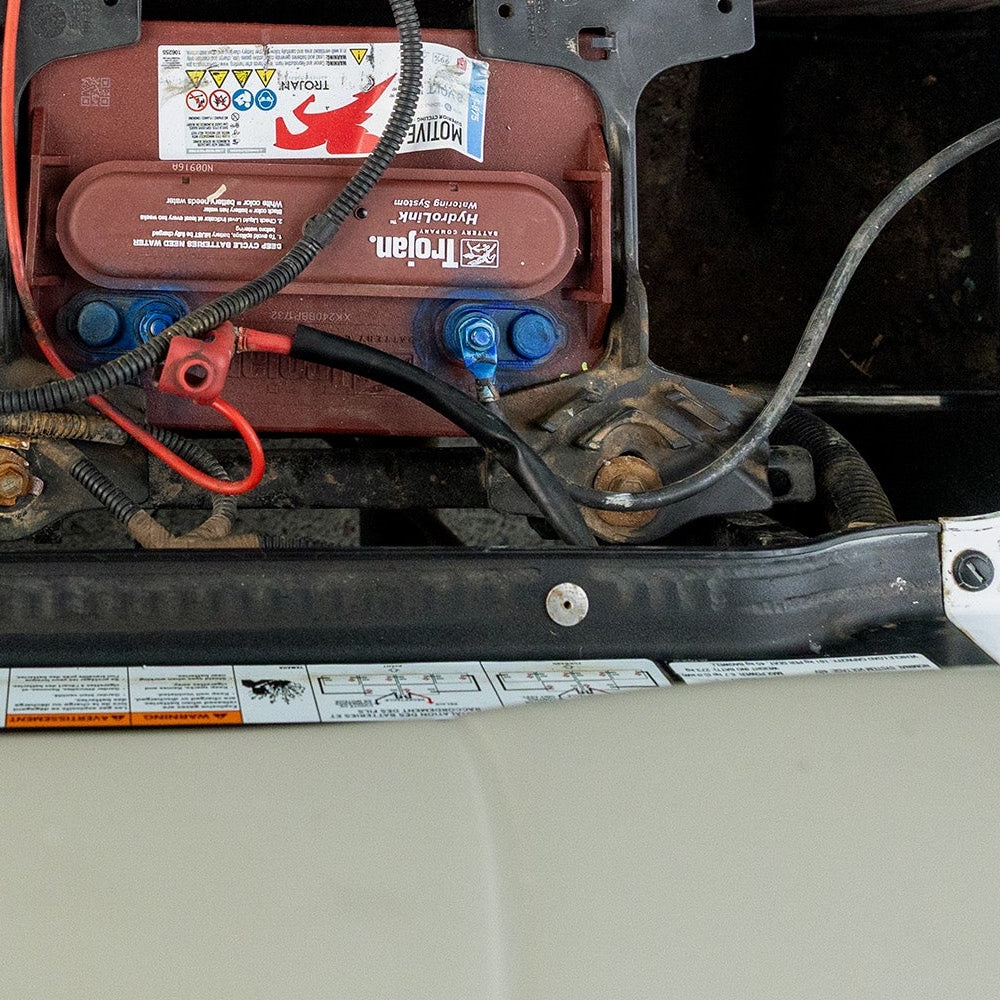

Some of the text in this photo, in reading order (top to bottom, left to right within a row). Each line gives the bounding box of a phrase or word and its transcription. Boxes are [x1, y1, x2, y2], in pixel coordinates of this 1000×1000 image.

[281, 80, 330, 91] TROJAN
[407, 121, 462, 146] MOTIVE
[394, 199, 477, 209] Watering System
[133, 239, 162, 247] WATER
